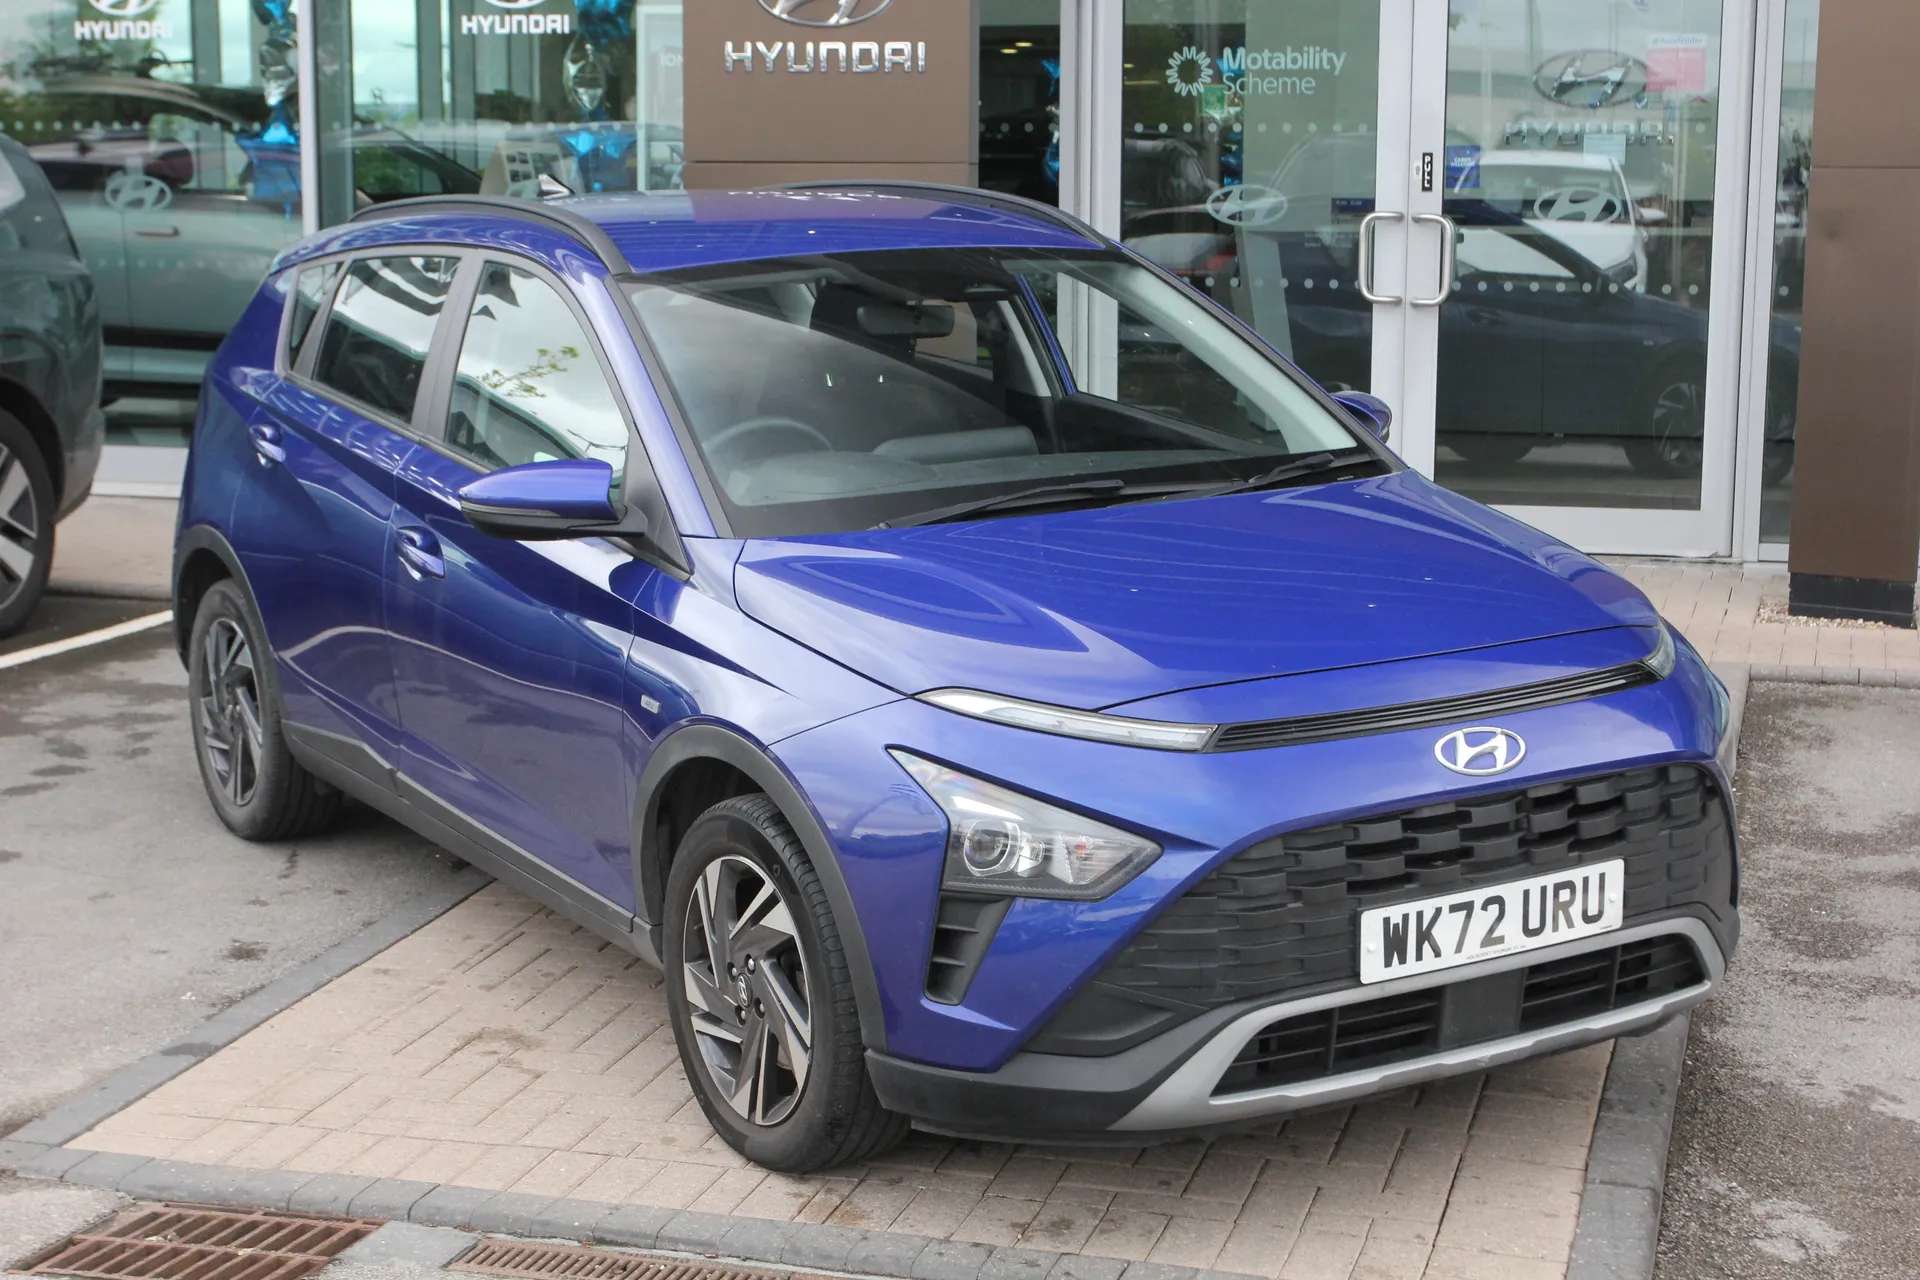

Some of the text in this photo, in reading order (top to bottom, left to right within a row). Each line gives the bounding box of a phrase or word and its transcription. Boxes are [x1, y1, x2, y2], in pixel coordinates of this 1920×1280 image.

[74, 20, 173, 39] HYUNDAI
[461, 14, 570, 34] HYUNDAI
[724, 41, 926, 72] HYUNDAI
[1222, 46, 1346, 76] Motability
[1223, 72, 1316, 95] Scheme
[1382, 871, 1606, 969] WK72 URU
